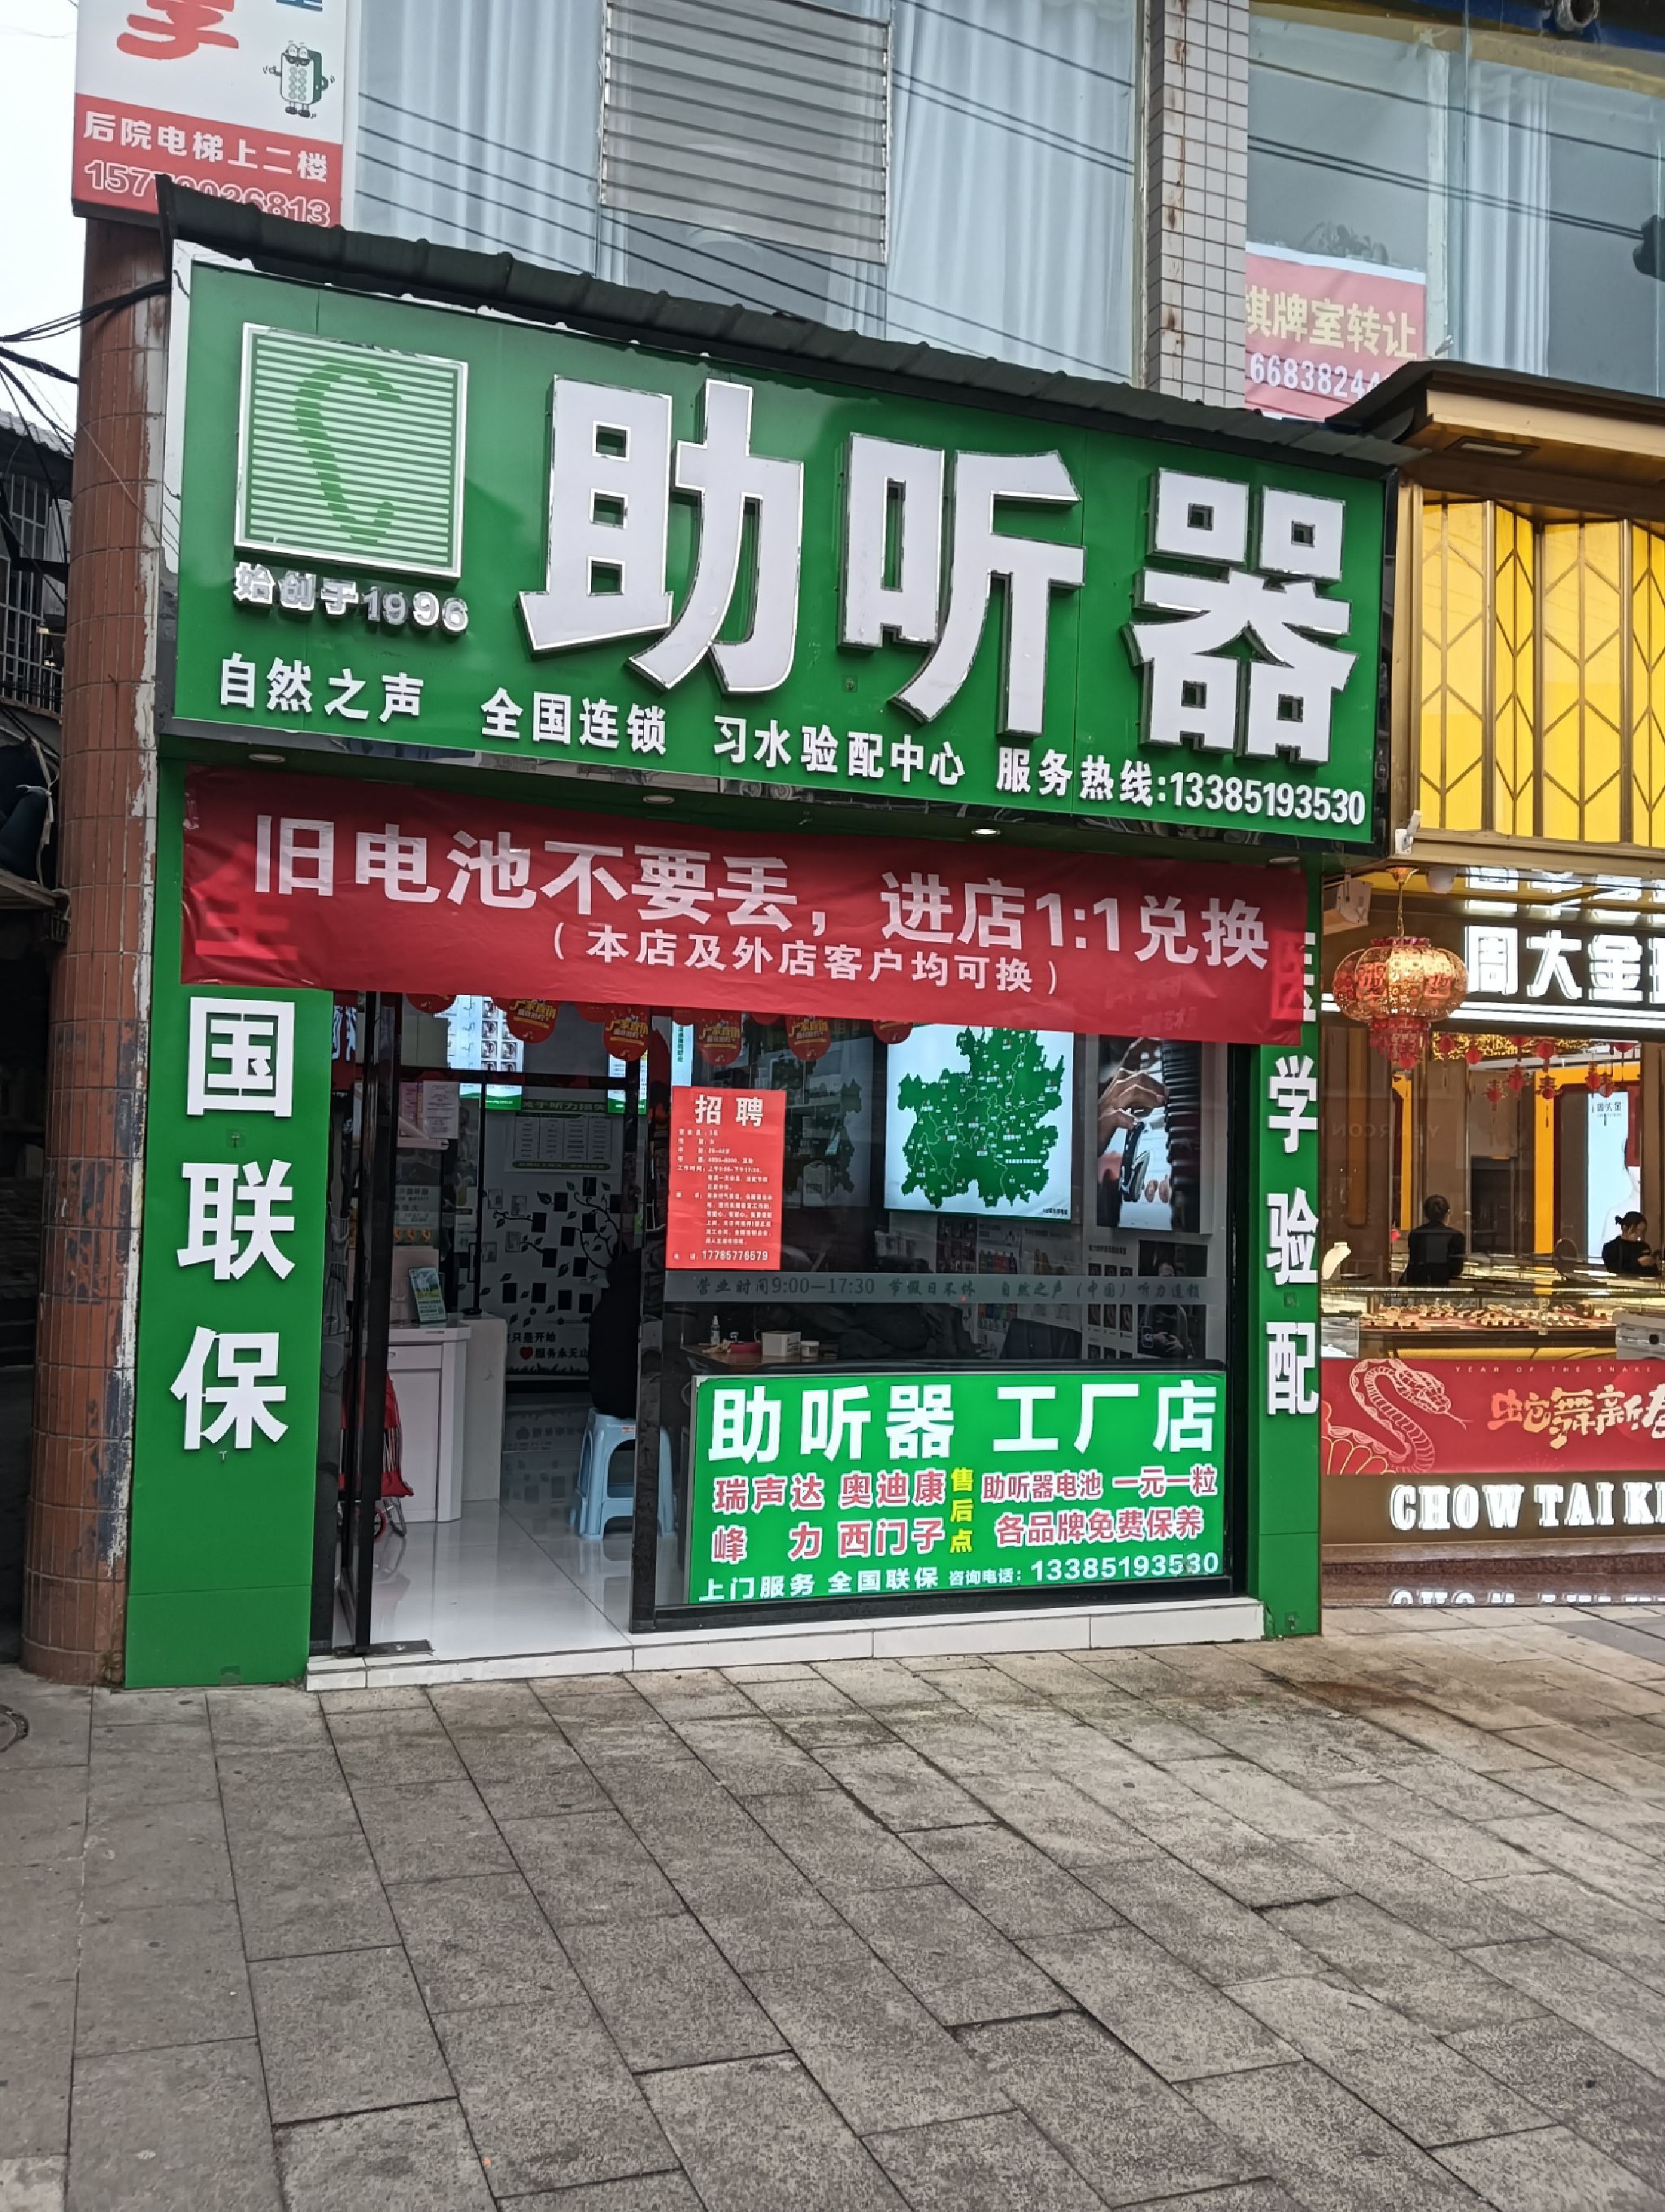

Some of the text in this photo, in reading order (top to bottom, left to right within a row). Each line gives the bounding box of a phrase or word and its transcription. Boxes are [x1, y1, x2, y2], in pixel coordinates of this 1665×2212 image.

[84, 111, 326, 182] 后院电梯上二楼
[519, 375, 1358, 765] 助听器
[233, 562, 469, 632] 始创于1996
[220, 652, 424, 723] 自然之声
[480, 687, 667, 755] 全国连锁
[714, 715, 966, 785] 习水验配中心
[695, 1094, 763, 1127] 招聘
[1455, 1365, 1500, 1373] YEAR
[1598, 1365, 1651, 1373] SNAKE
[708, 1379, 1217, 1464] 助听器 工厂店
[712, 1467, 946, 1515] 瑞声达 奥迪康
[980, 1463, 1218, 1503] 助听器电池 一元一粒
[1390, 1484, 1525, 1531] CHOW
[1533, 1482, 1615, 1527] TAI
[950, 1467, 974, 1553] 售后点
[993, 1505, 1204, 1549] 各品牌免费保养
[837, 1517, 946, 1558] 西门子
[698, 1573, 815, 1601] 上门服务
[827, 1567, 939, 1594] 全国联保
